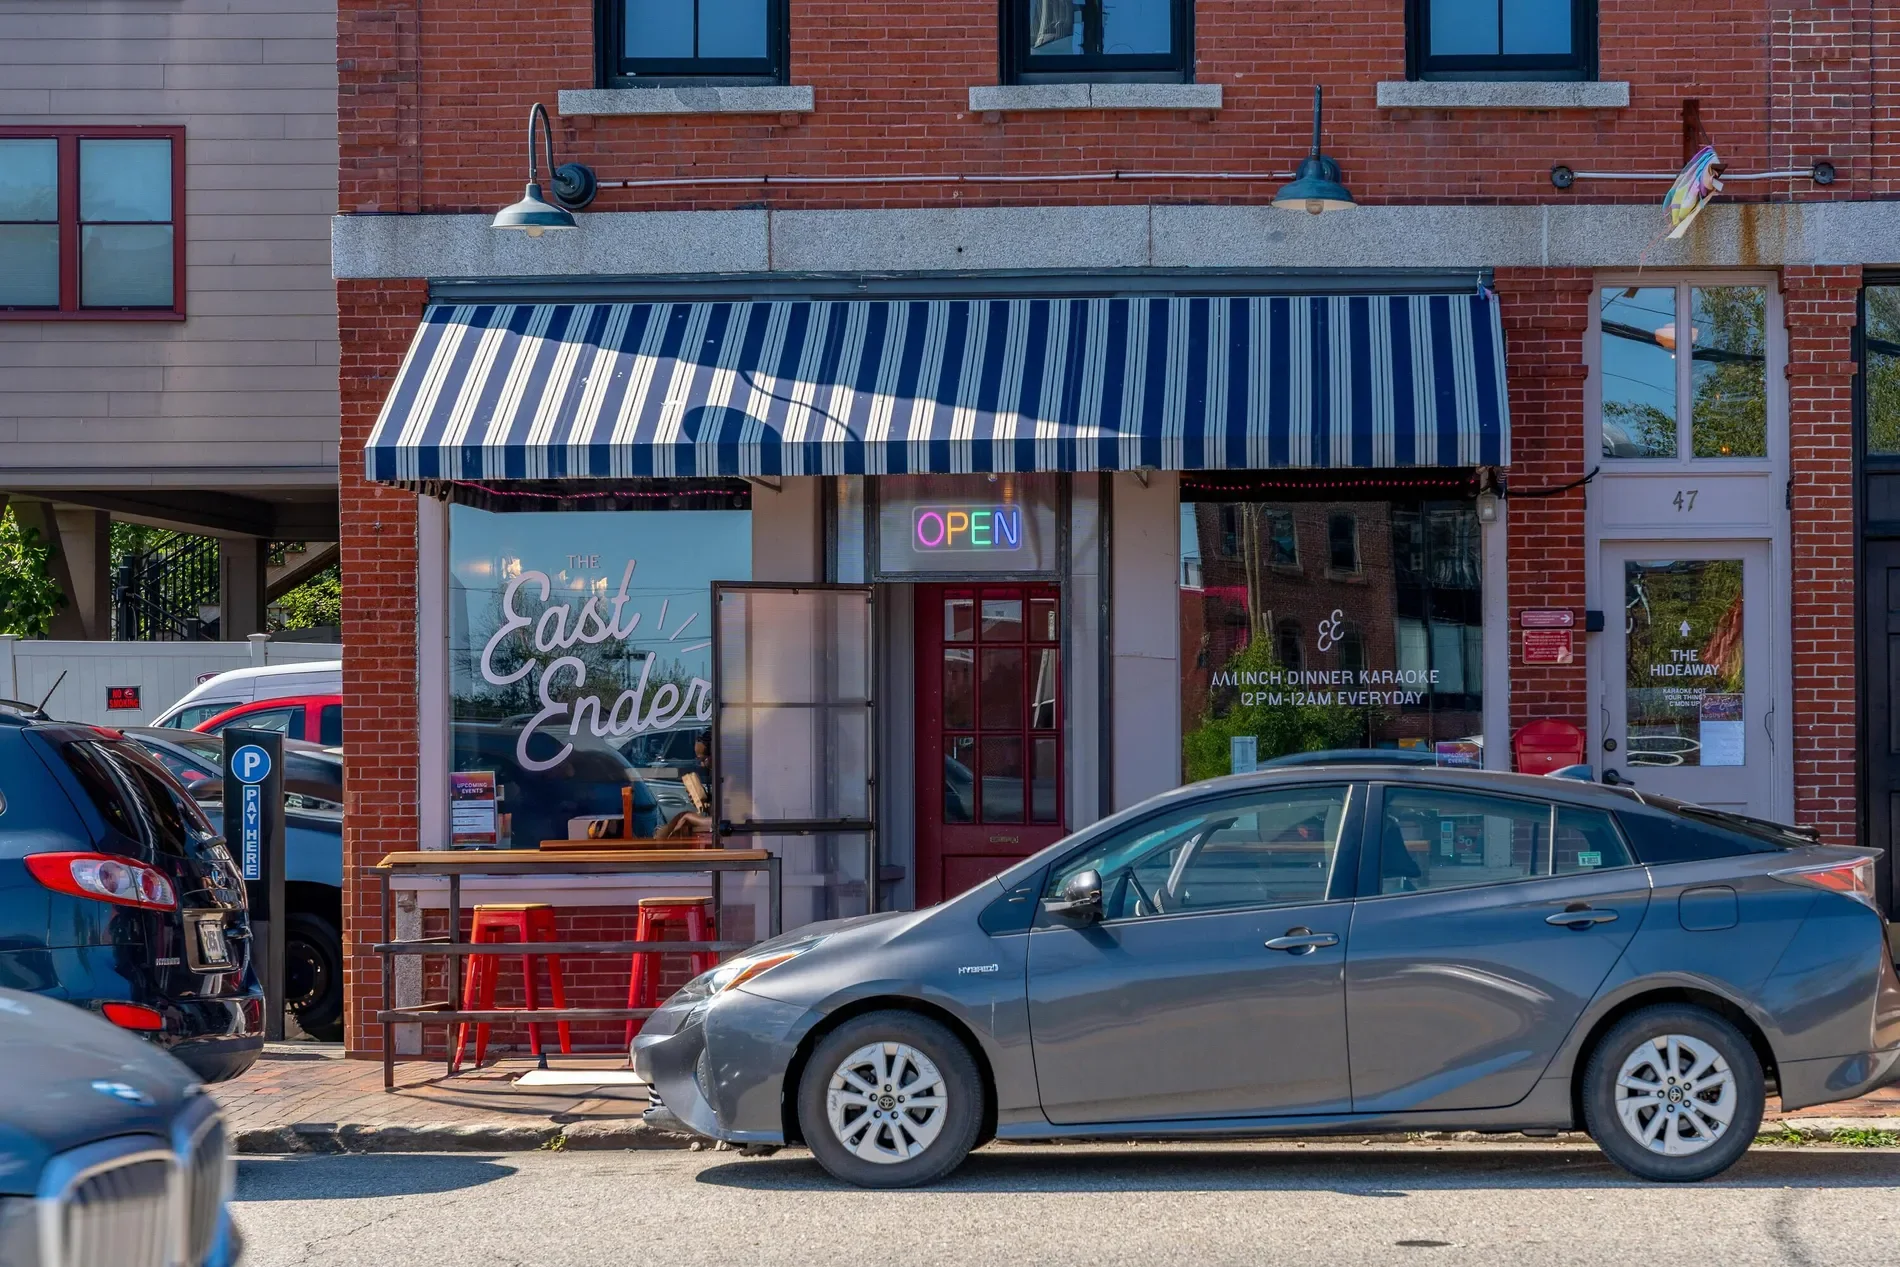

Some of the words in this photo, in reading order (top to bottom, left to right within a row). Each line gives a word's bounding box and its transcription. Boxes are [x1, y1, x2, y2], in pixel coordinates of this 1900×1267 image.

[1672, 489, 1699, 513] 47
[917, 511, 1017, 547] OPEN
[566, 554, 601, 569] THE
[480, 558, 642, 685] East
[1670, 649, 1699, 662] THE
[1287, 669, 1354, 686] DINNER
[1358, 668, 1440, 685] KARAOKE
[1650, 663, 1720, 677] HIDEAWAY
[109, 698, 140, 709] SMOKING
[111, 688, 122, 699] NO
[1336, 690, 1424, 706] EVERYDAY
[516, 651, 712, 772] Ender
[244, 752, 262, 778] P
[246, 789, 258, 825] PAY
[245, 829, 258, 877] HERE
